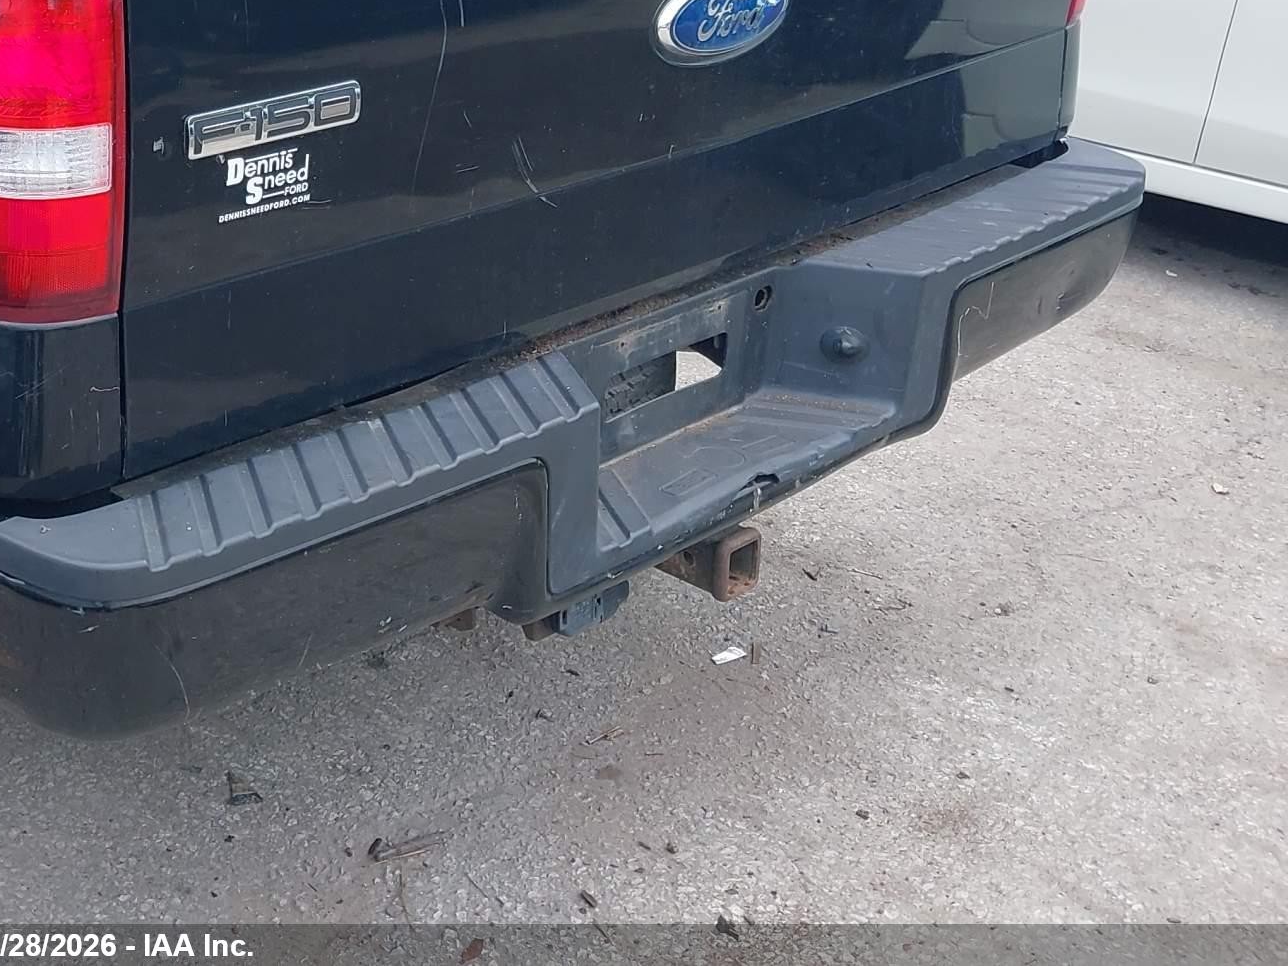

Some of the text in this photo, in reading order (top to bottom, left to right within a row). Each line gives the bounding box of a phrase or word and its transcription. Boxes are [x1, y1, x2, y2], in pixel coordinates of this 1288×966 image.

[192, 85, 358, 155] F-150
[226, 149, 294, 186] Dennis
[245, 153, 310, 205] Sneed
[284, 182, 309, 196] FORD
[218, 193, 311, 224] DENNISSNEEDFORD.COM
